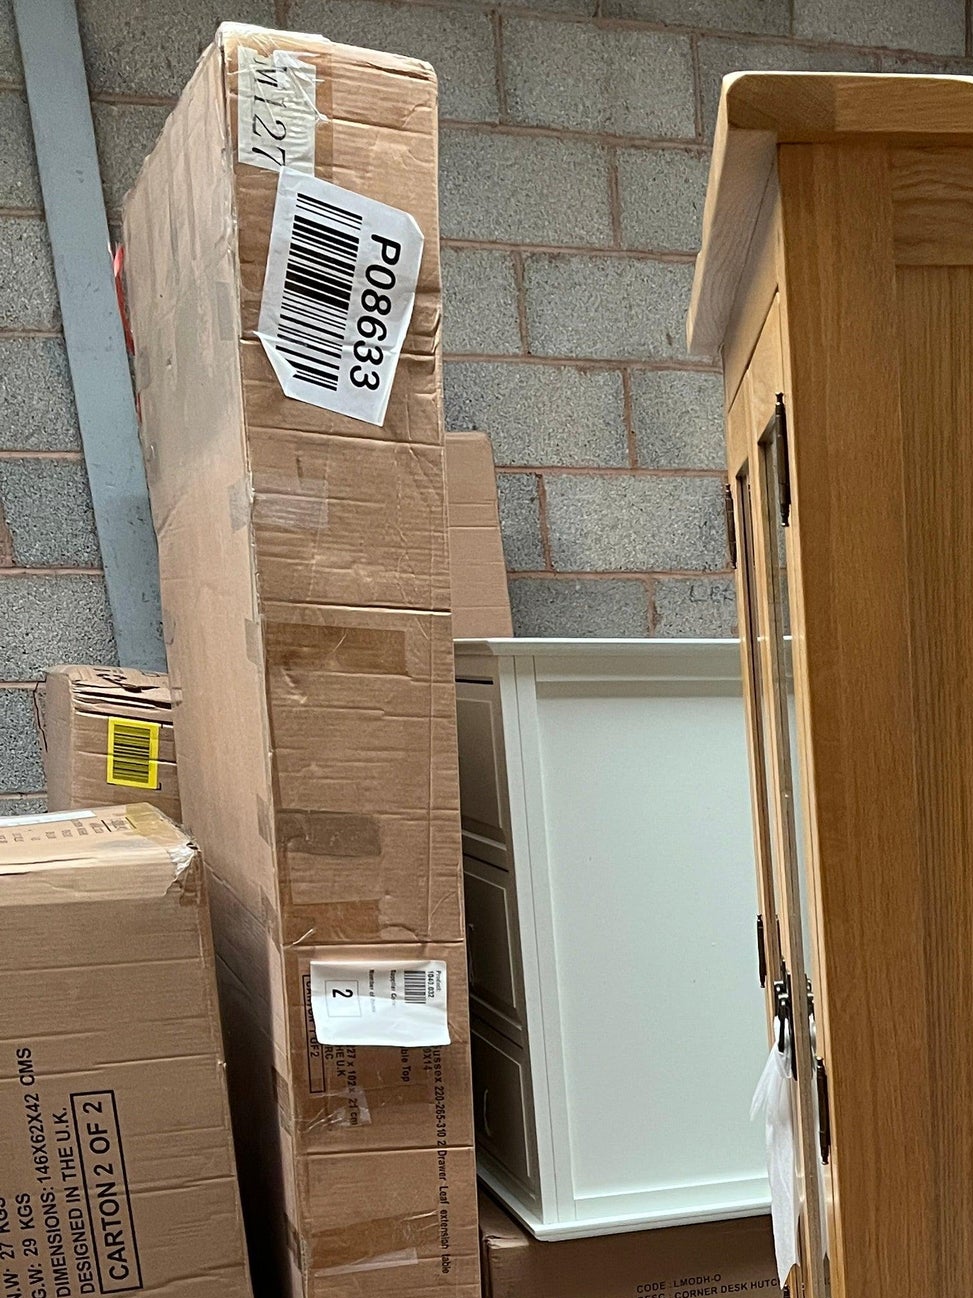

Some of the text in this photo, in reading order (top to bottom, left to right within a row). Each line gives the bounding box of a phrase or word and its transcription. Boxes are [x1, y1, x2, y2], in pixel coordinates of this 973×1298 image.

[350, 234, 402, 391] P08633
[332, 988, 354, 998] 2
[401, 1063, 411, 1082] Top
[434, 1085, 447, 1137] 220-265-310
[16, 1047, 71, 1298] DIMENSIONS: 146X62X42 CMS
[437, 1150, 447, 1181] Drawer
[52, 1106, 96, 1295] DESIGNED IN THE U.K.
[82, 1100, 130, 1281] CARTON 2 OF 2
[439, 1185, 449, 1204] Leaf
[16, 1192, 35, 1230] KGS
[440, 1209, 450, 1250] extension
[1, 1241, 15, 1260] 27
[22, 1237, 39, 1257] 29
[636, 1273, 722, 1294] CODE LMODH-O
[720, 1283, 748, 1294] DESK
